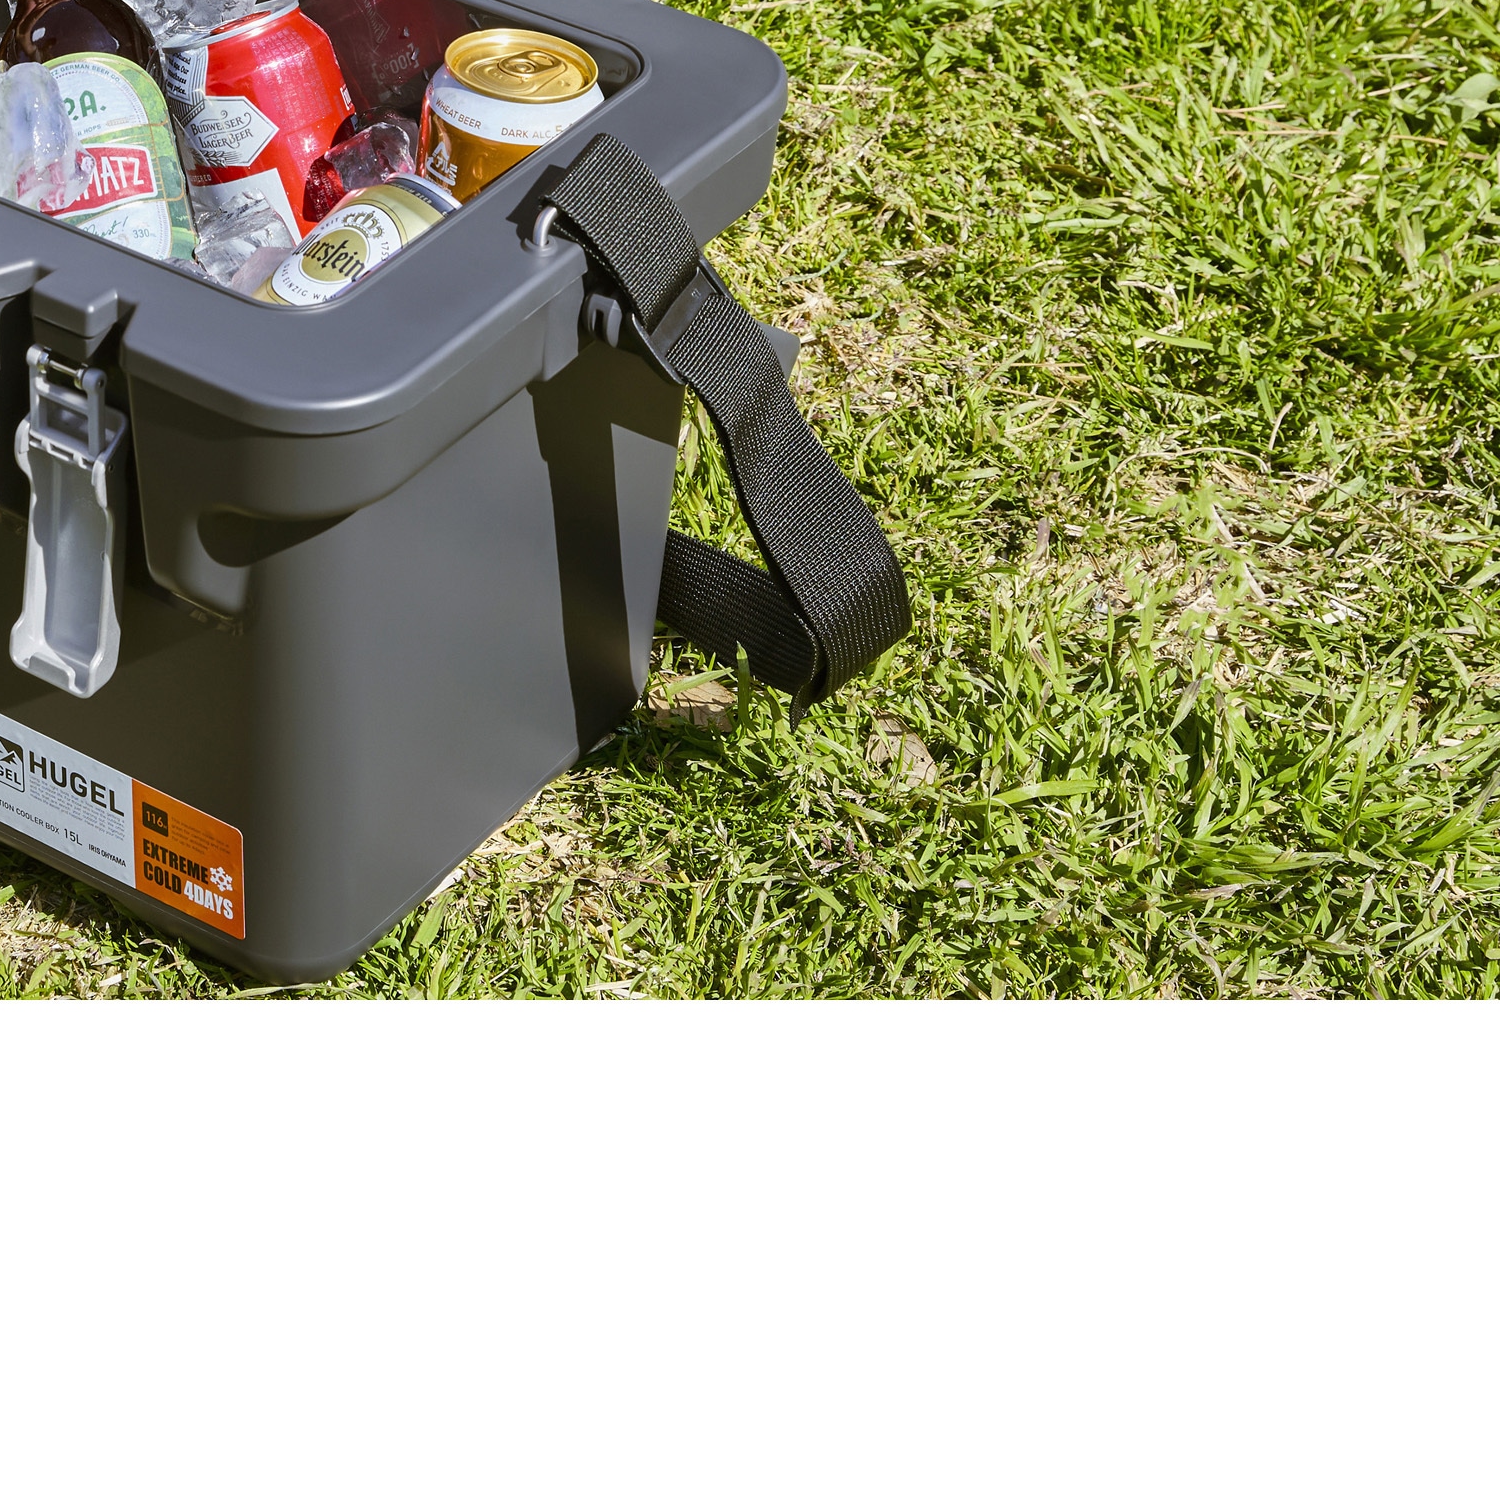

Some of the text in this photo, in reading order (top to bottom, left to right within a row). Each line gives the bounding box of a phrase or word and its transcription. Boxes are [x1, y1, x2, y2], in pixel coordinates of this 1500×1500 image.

[60, 63, 90, 73] GERMAN
[91, 65, 110, 76] BEER
[84, 124, 102, 135] HOPS
[190, 117, 245, 136] BUDWEISER
[198, 128, 254, 149] LAGER BEER
[435, 97, 458, 118] WHEAT
[458, 113, 482, 130] BEER
[501, 127, 529, 139] DARK
[76, 156, 145, 201] MATZ
[292, 233, 366, 282] Warstein
[29, 750, 125, 817] HUGEL
[16, 806, 44, 827] COOLER
[45, 821, 60, 834] BOX
[63, 828, 82, 846] 15L
[88, 843, 127, 867] IRIS OHYAMA
[143, 838, 209, 885] EXTREME
[143, 860, 234, 920] COLD 4DAYS
